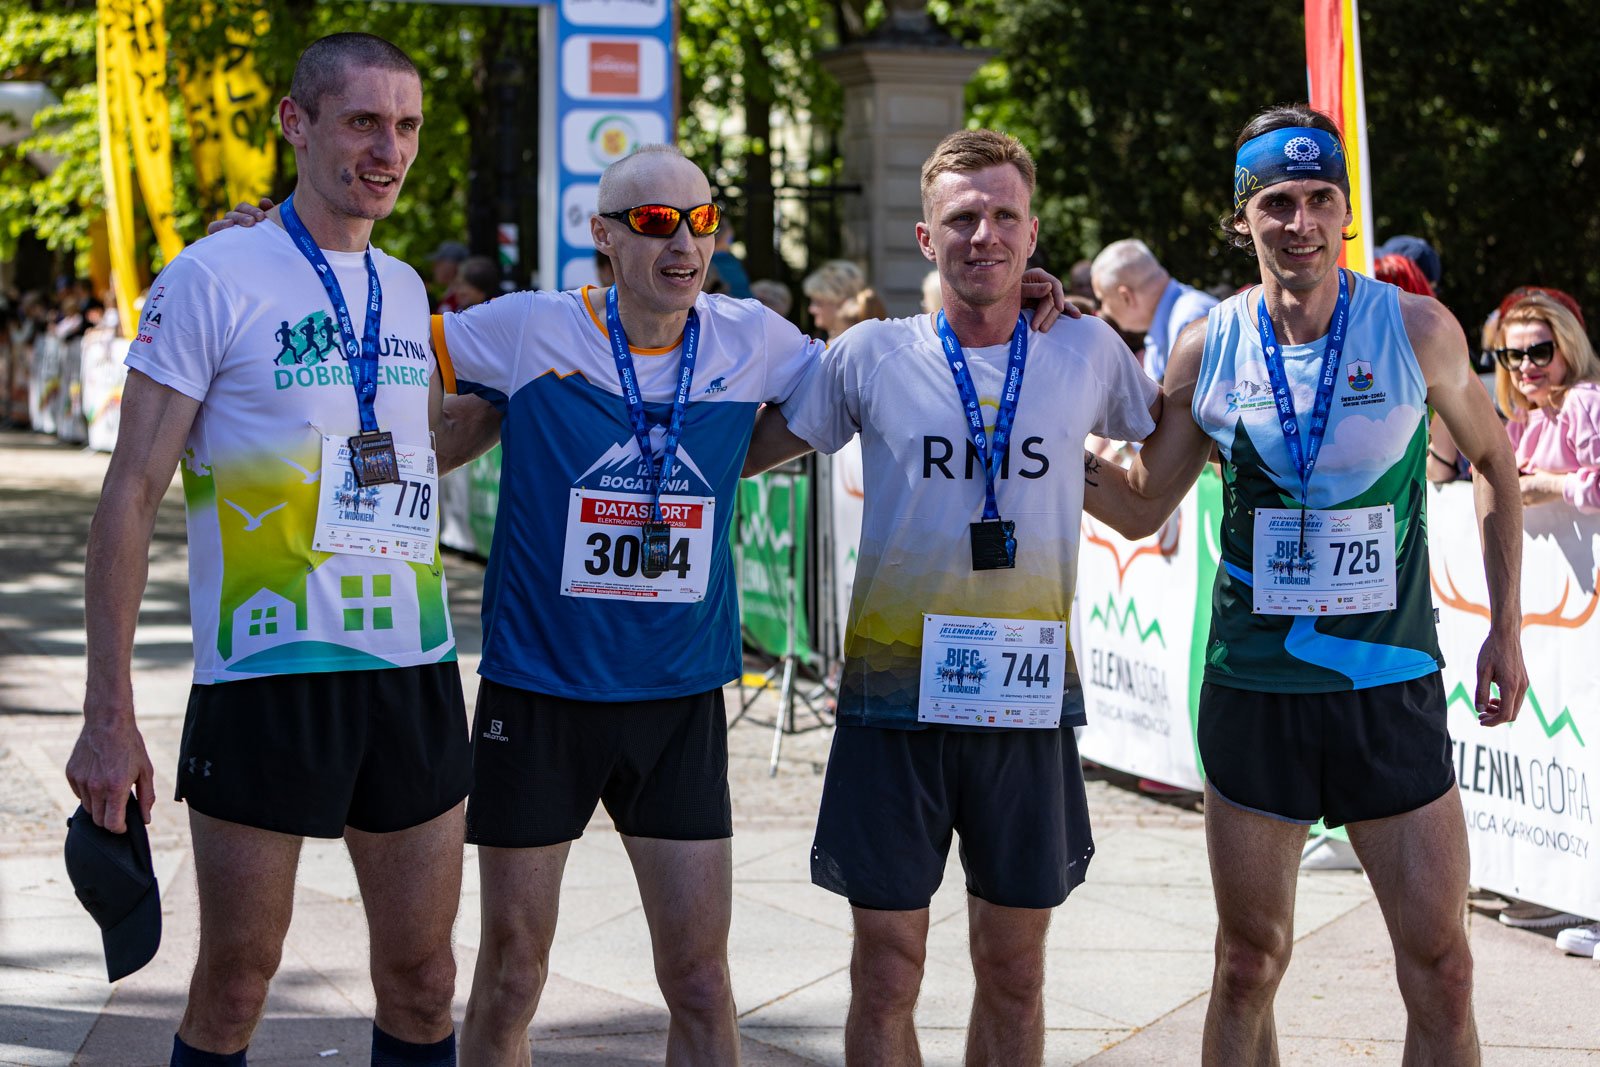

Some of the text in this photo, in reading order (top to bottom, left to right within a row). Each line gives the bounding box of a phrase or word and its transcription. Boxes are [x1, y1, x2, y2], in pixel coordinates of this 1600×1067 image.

[365, 334, 428, 362] UŻYNA
[1326, 348, 1335, 377] RADIO
[274, 365, 354, 390] DOBRE
[622, 368, 631, 396] RADIO
[1007, 366, 1017, 393] RADIO
[599, 474, 689, 492] BOGATNIA
[636, 463, 681, 477] IZEY
[393, 480, 431, 521] 778
[344, 511, 375, 522] WIDOKIEM
[597, 518, 646, 526] ELEKTRONICZNY
[1329, 539, 1380, 576] 725
[1279, 577, 1310, 586] WIDOKIEM
[945, 647, 979, 668] BIEG
[1001, 652, 1050, 688] 744
[942, 684, 980, 694] Z WIDOKIEM
[1452, 739, 1592, 825] LENIA GÓRA
[1502, 817, 1589, 859] KARKONOSZY
